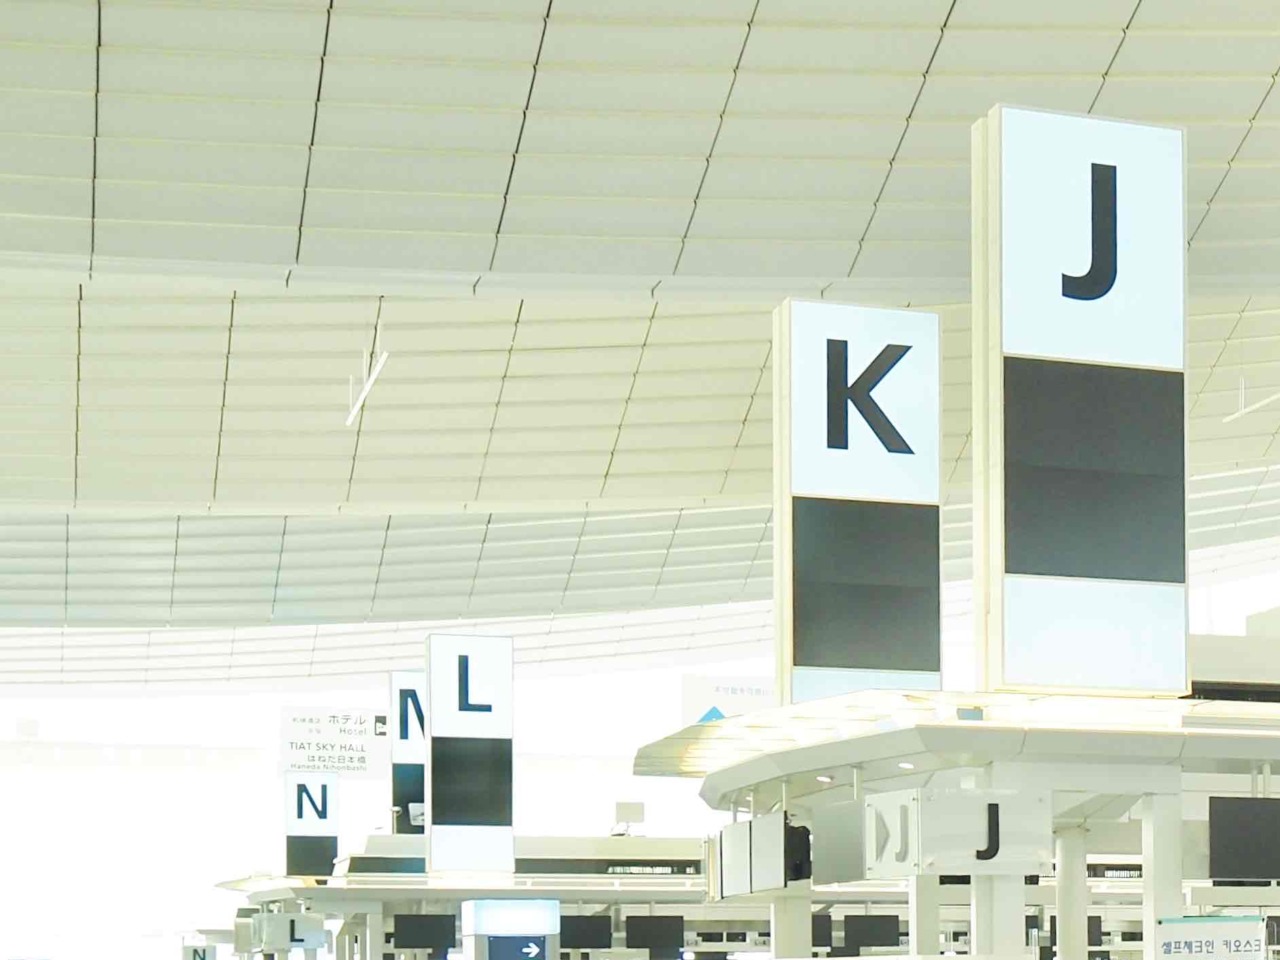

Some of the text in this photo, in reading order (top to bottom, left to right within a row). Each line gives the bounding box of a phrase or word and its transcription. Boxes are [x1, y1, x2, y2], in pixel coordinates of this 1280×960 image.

[1061, 162, 1117, 300] J
[826, 338, 915, 454] K
[458, 655, 492, 712] L
[328, 714, 367, 725] ホテル
[339, 727, 367, 736] Hotel
[289, 741, 367, 753] TIAT SKY HALL
[296, 783, 328, 819] N
[976, 803, 1000, 860] J
[289, 919, 305, 942] L
[1222, 939, 1261, 953] 키오스크
